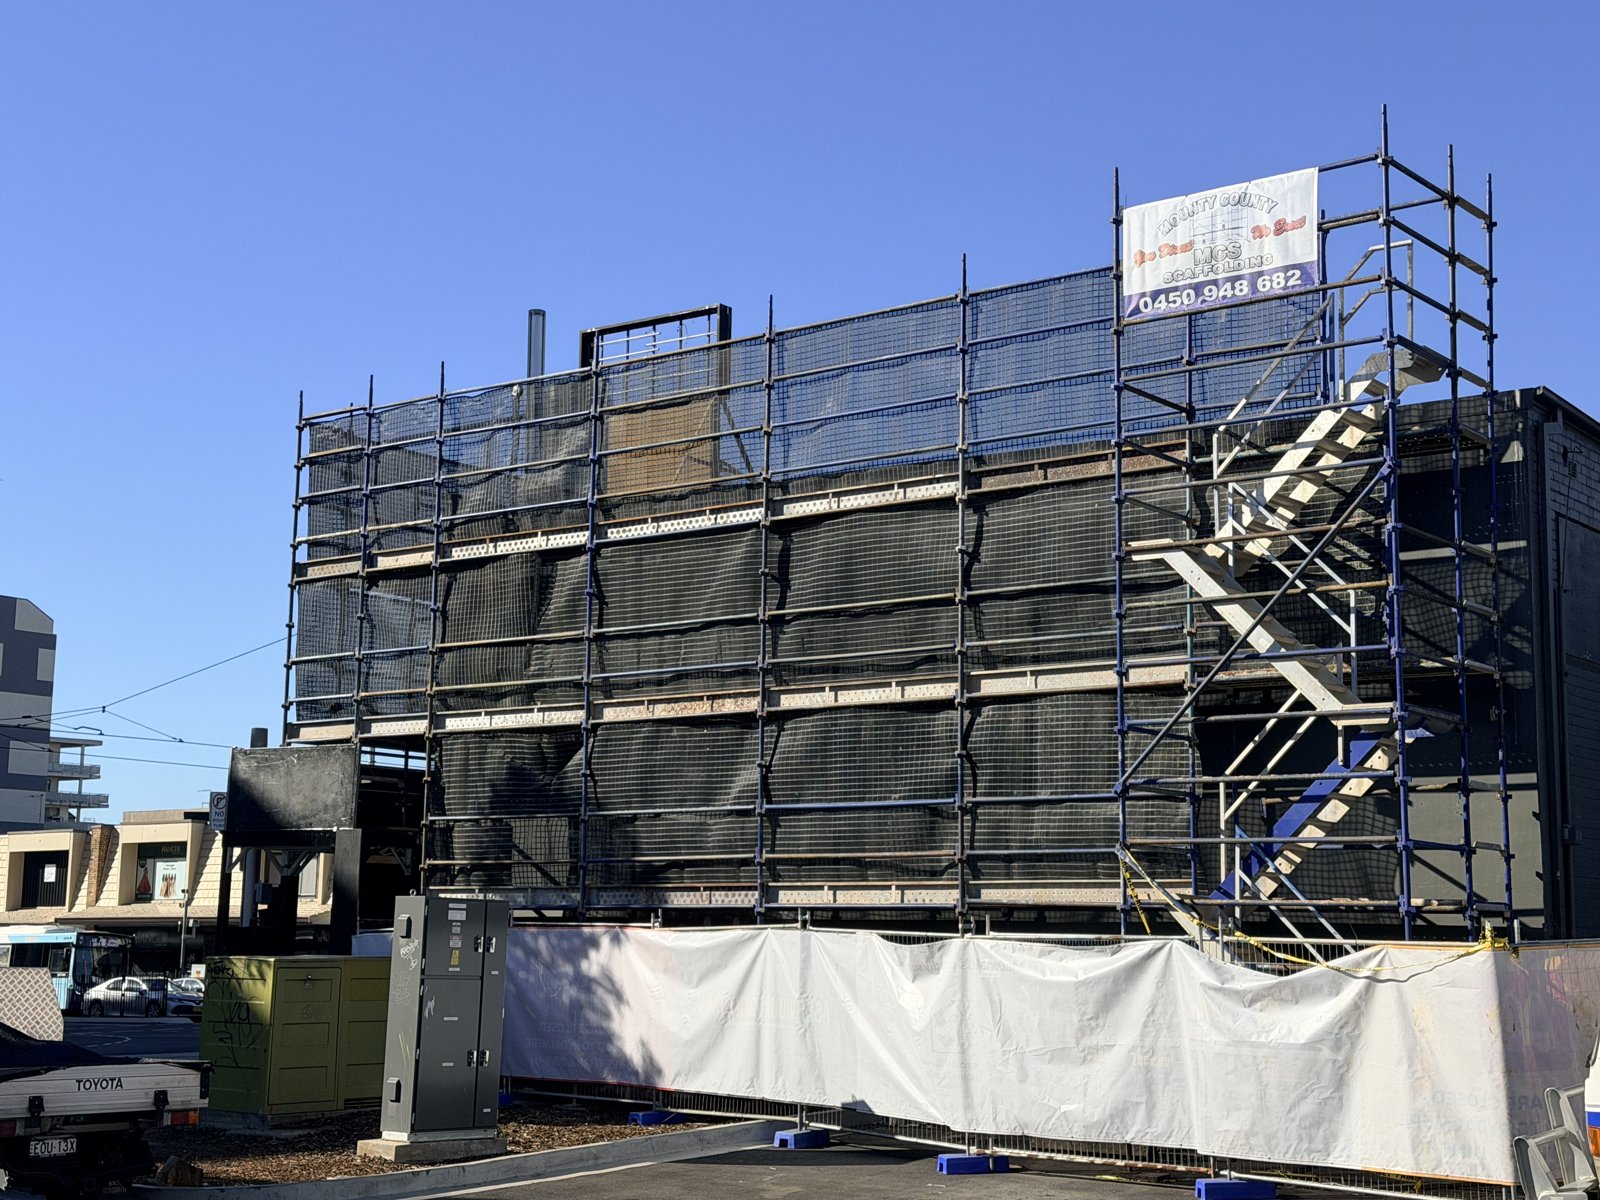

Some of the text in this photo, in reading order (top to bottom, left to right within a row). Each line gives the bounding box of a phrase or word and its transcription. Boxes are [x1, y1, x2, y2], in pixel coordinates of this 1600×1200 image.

[1158, 191, 1279, 237] MOUNTY COUNTY
[1194, 241, 1242, 266] MCS
[1163, 253, 1274, 284] SCAFFOLDING
[1139, 269, 1301, 313] 0450 948 682
[214, 810, 224, 818] NO
[76, 1077, 123, 1091] TOYOTA
